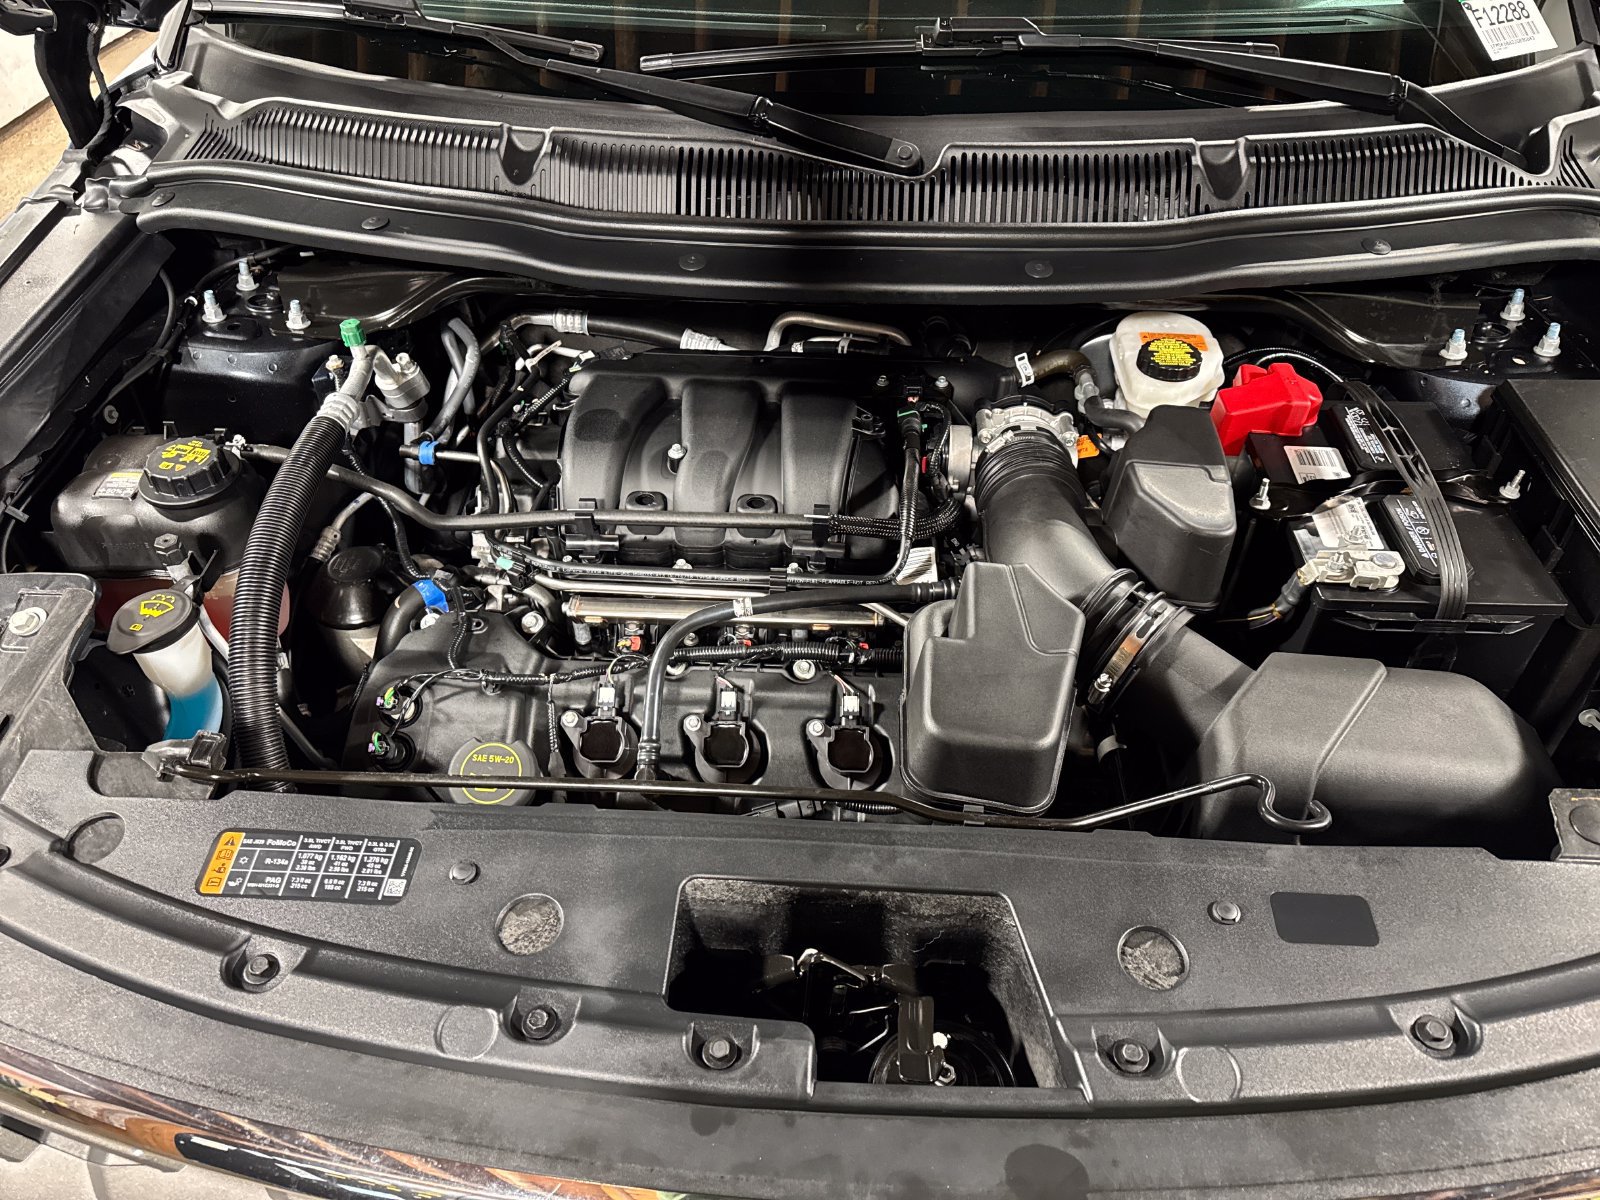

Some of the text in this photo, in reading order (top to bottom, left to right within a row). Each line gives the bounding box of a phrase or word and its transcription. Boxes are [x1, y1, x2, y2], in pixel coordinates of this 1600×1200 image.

[1471, 1, 1530, 28] F12288
[472, 754, 514, 764] SAE 5W-20
[266, 838, 297, 846] FoMoCo
[264, 857, 289, 865] R-134a
[314, 853, 323, 861] kg
[347, 855, 356, 863] kg
[380, 857, 389, 865] kg
